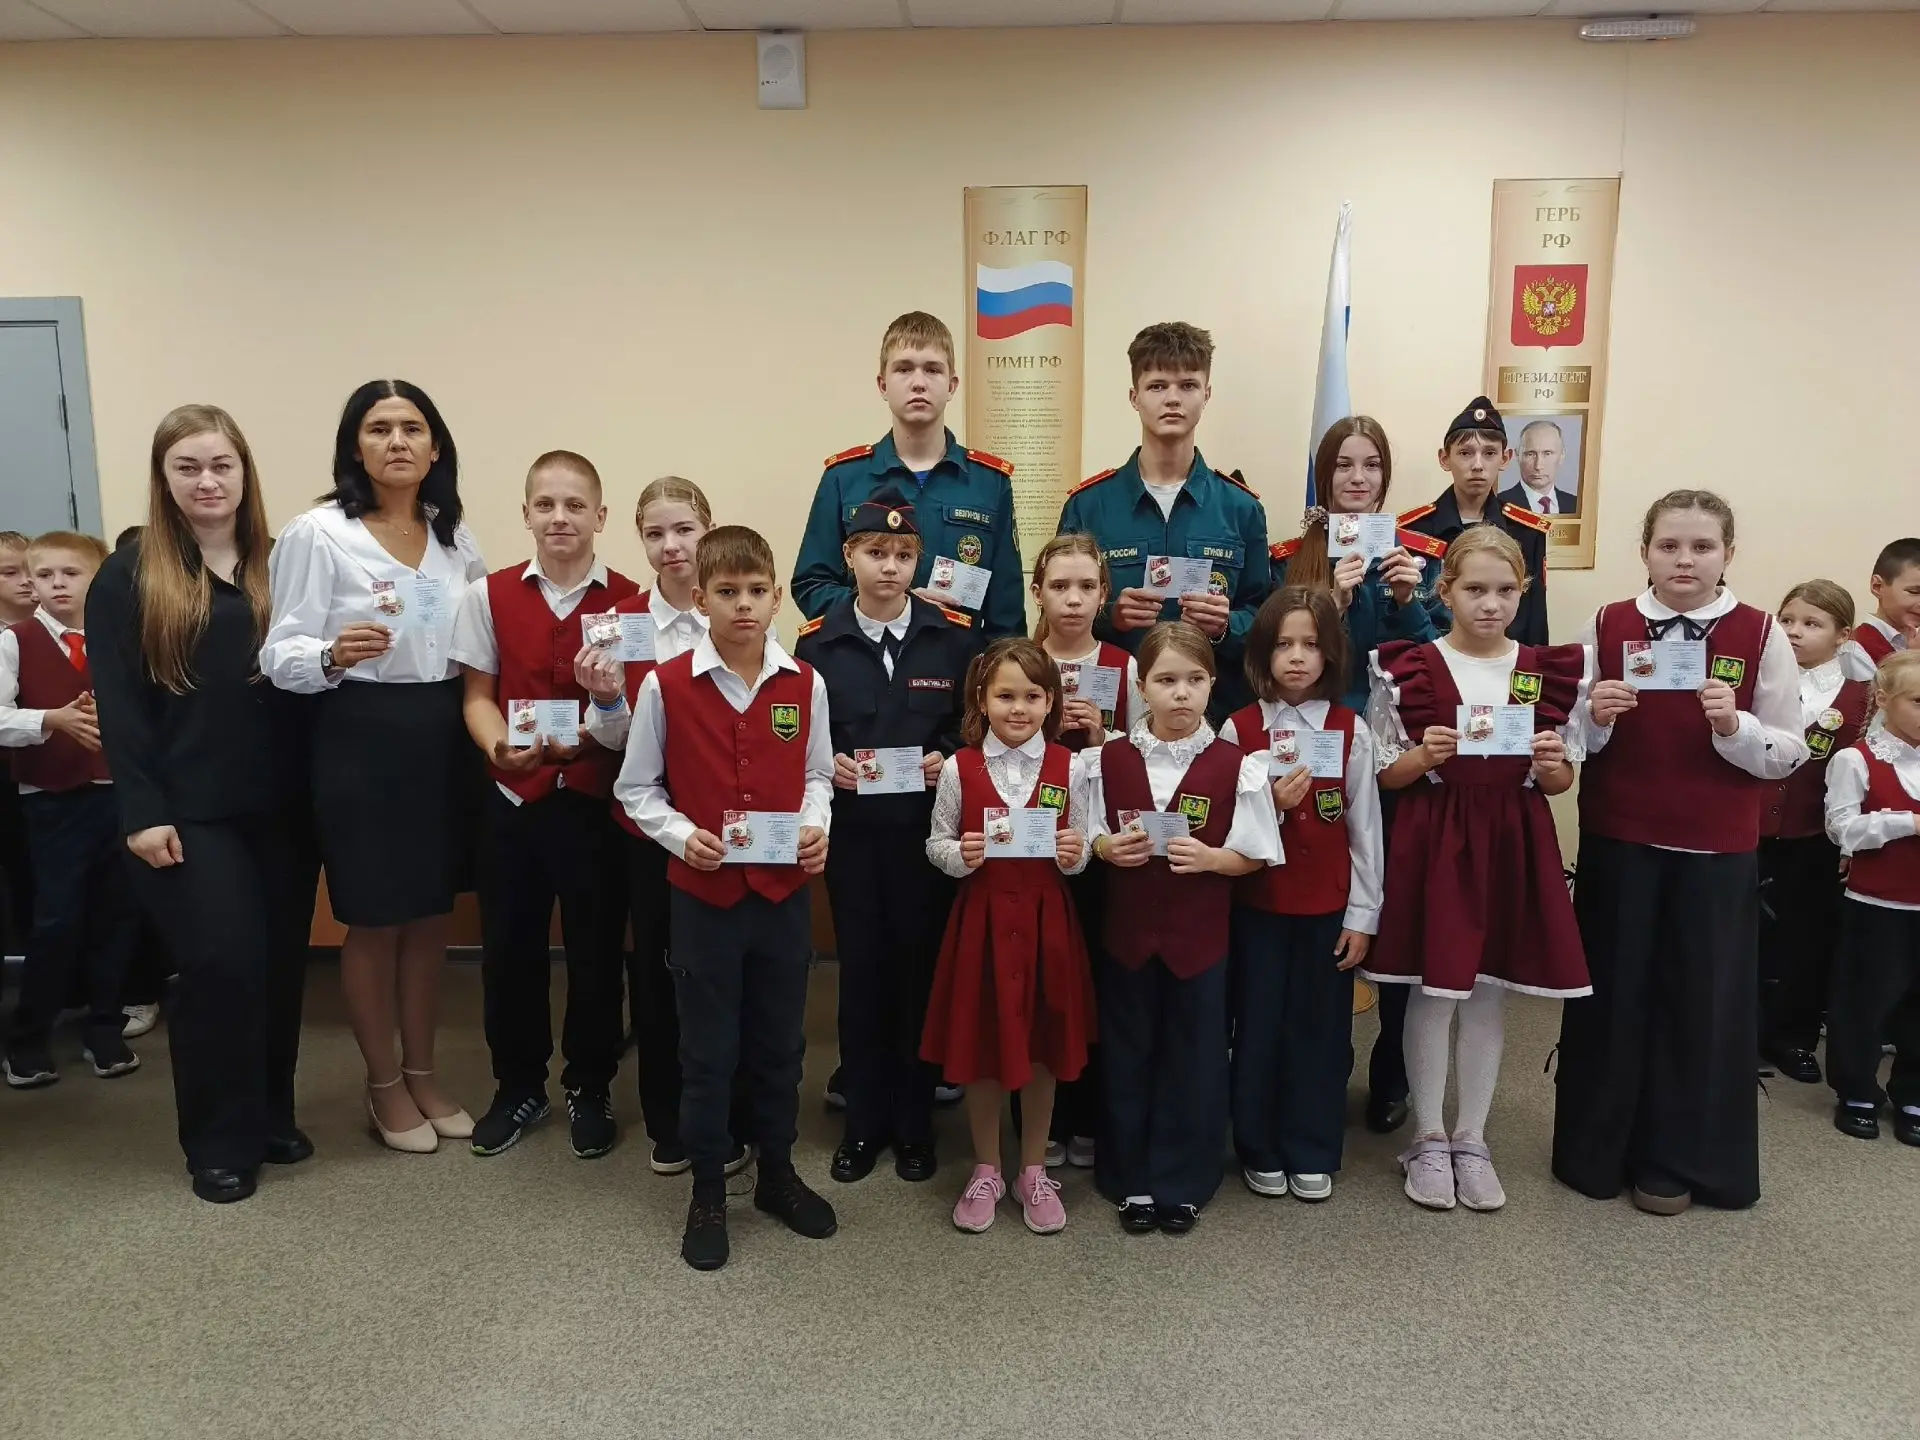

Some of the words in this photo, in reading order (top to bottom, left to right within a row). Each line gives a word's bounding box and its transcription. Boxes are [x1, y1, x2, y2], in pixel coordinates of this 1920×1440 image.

[1535, 206, 1581, 222] ГЕРБ
[982, 231, 1038, 246] ФЛАГ
[1043, 230, 1071, 245] РФ
[1541, 233, 1572, 249] РФ
[987, 356, 1034, 370] ГИМН
[1039, 355, 1062, 369] РФ
[1504, 371, 1588, 384] ПРЕЗИДЕНТ
[1534, 388, 1554, 399] РФ
[1109, 547, 1138, 558] РОССИИ
